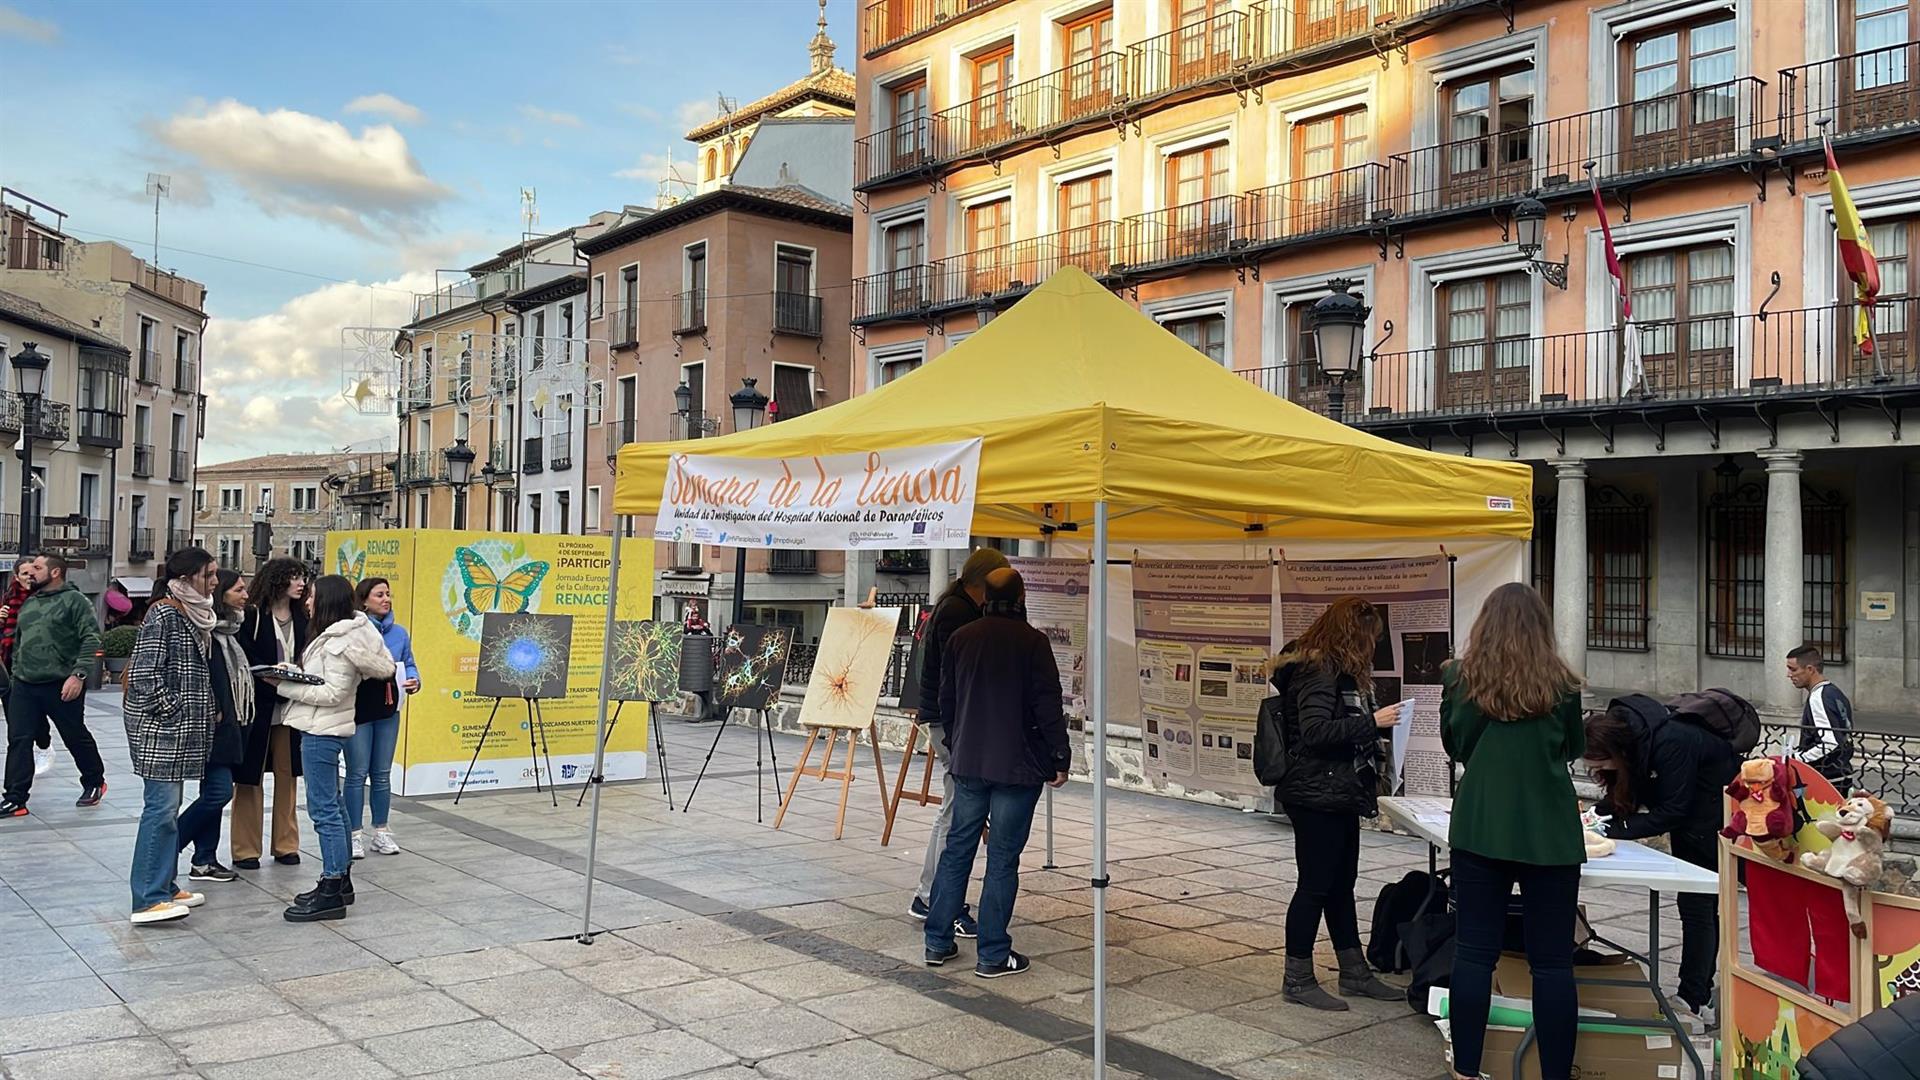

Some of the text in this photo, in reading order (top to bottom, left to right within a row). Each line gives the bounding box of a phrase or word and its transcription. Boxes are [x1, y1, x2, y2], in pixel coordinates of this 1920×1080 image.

[670, 451, 967, 508] Semana de la Ciencia
[674, 508, 700, 519] Unidad
[701, 509, 710, 520] de
[758, 510, 772, 522] del
[774, 510, 813, 524] Hospital
[815, 510, 861, 522] Nacional
[864, 510, 876, 522] de
[880, 508, 944, 525] Parapléjicos
[367, 540, 400, 555] RENACER
[557, 558, 621, 569] ¡PARTICIP!
[586, 574, 610, 582] Europe
[574, 583, 600, 591] Cultura
[556, 593, 617, 605] RENACE
